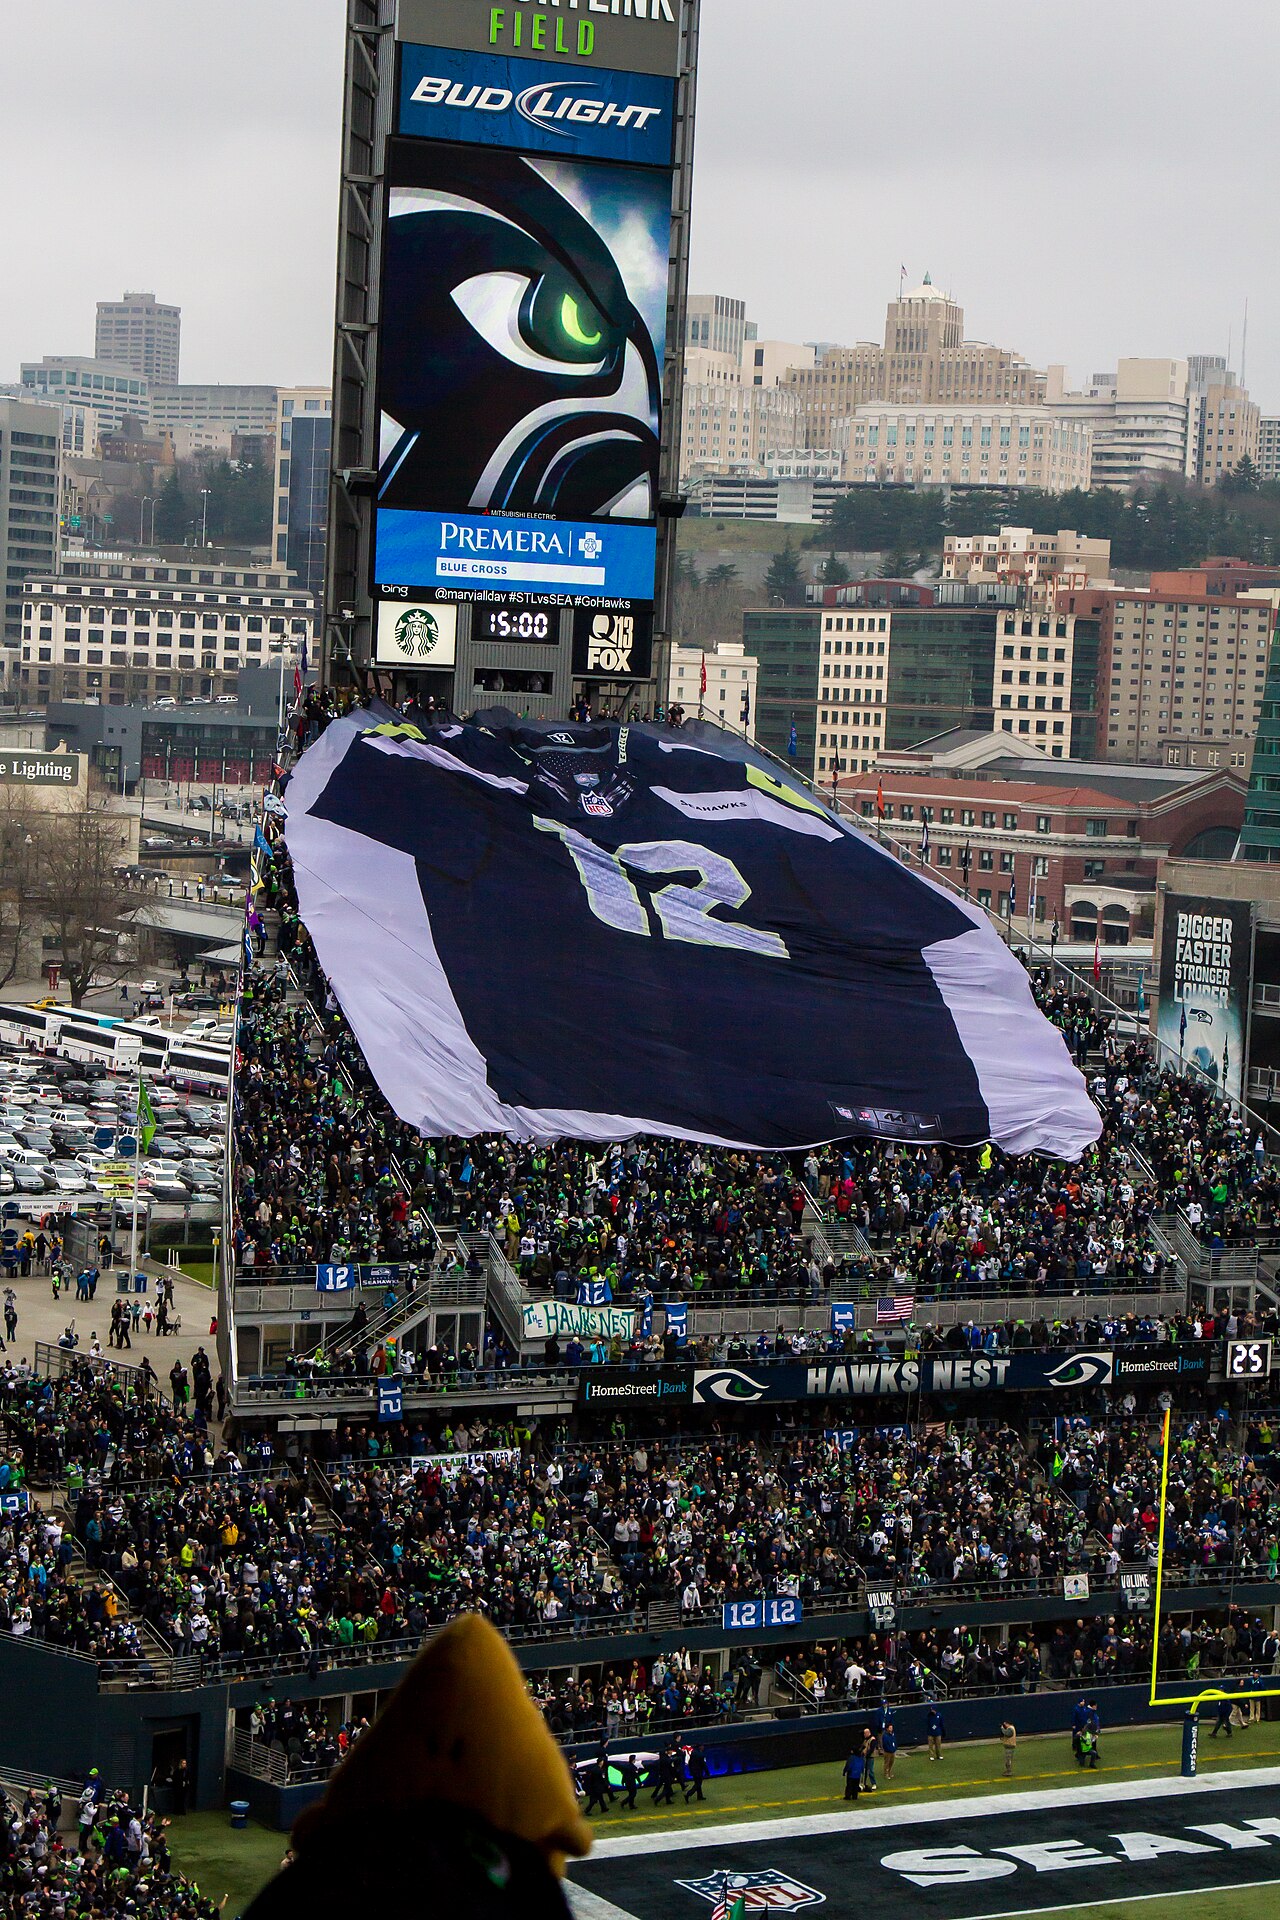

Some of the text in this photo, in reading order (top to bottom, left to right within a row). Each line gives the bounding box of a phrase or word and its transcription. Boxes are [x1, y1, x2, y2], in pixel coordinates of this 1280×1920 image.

[490, 8, 595, 56] FIELD
[410, 76, 662, 129] BUD LIGHT
[490, 509, 557, 521] MITSUBISHI ELECTRIC
[440, 521, 564, 555] PREMERA
[440, 562, 508, 575] BLUE CROSS
[381, 583, 409, 597] bing
[509, 591, 573, 605] #STLvsSEA
[574, 595, 631, 609] #GoHawks
[490, 611, 548, 638] 15:00
[587, 649, 632, 672] FOX
[12, 760, 73, 781] Lighting
[587, 804, 610, 813] NFL
[680, 799, 748, 813] SEAHAWKS
[531, 813, 791, 959] 12
[1177, 913, 1233, 944] BIGGER
[1175, 938, 1232, 968] FASTER
[1174, 963, 1230, 987] STRONGER
[1173, 982, 1229, 1010] LOUDER
[326, 1266, 349, 1289] 12
[582, 1282, 605, 1304] 12
[523, 1304, 544, 1328] THE
[600, 1307, 635, 1342] NEST
[731, 1342, 740, 1350] 25
[1182, 1359, 1204, 1371] Bank
[1233, 1344, 1263, 1373] 25
[662, 1381, 687, 1394] Bank
[807, 1359, 1011, 1394] HAWKS NEST
[379, 1386, 401, 1415] 12
[262, 1446, 271, 1456] 10
[833, 1431, 854, 1450] 12
[594, 1473, 604, 1483] 12
[884, 1518, 894, 1528] 80
[874, 1536, 881, 1545] 12
[813, 1580, 821, 1591] 12
[1120, 1573, 1149, 1589] VOLUME
[867, 1591, 895, 1608] VOLUME
[730, 1603, 756, 1626] 12
[770, 1599, 796, 1623] 12
[270, 1713, 276, 1723] 3
[1190, 1725, 1198, 1772] SEAHAWKS
[713, 1884, 812, 1907] NFL
